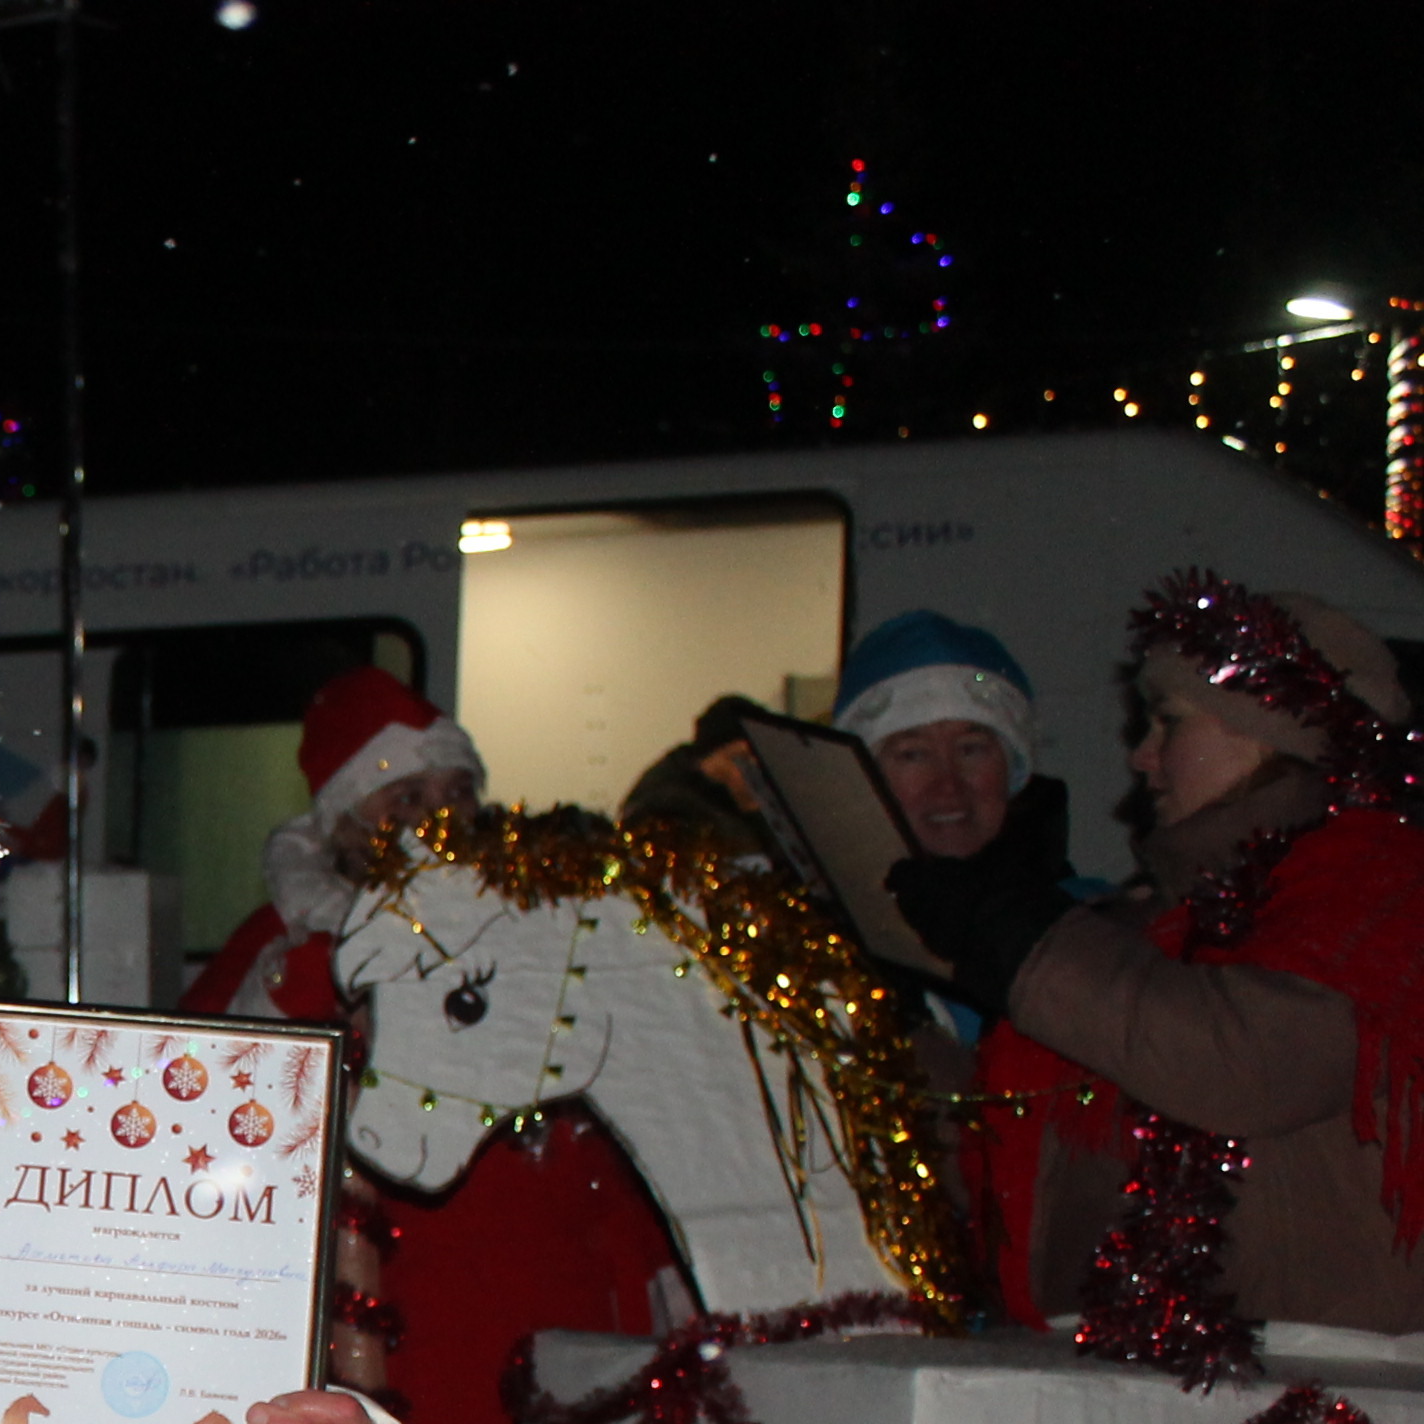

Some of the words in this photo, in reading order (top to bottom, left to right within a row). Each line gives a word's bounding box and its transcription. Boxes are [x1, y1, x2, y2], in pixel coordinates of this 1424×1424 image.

[4, 1163, 278, 1225] ДИПЛОМ
[25, 1284, 38, 1293] за
[41, 1285, 90, 1298] лучший
[95, 1289, 186, 1306] карнавальный
[191, 1297, 239, 1310] костюм
[174, 1324, 219, 1336] символ
